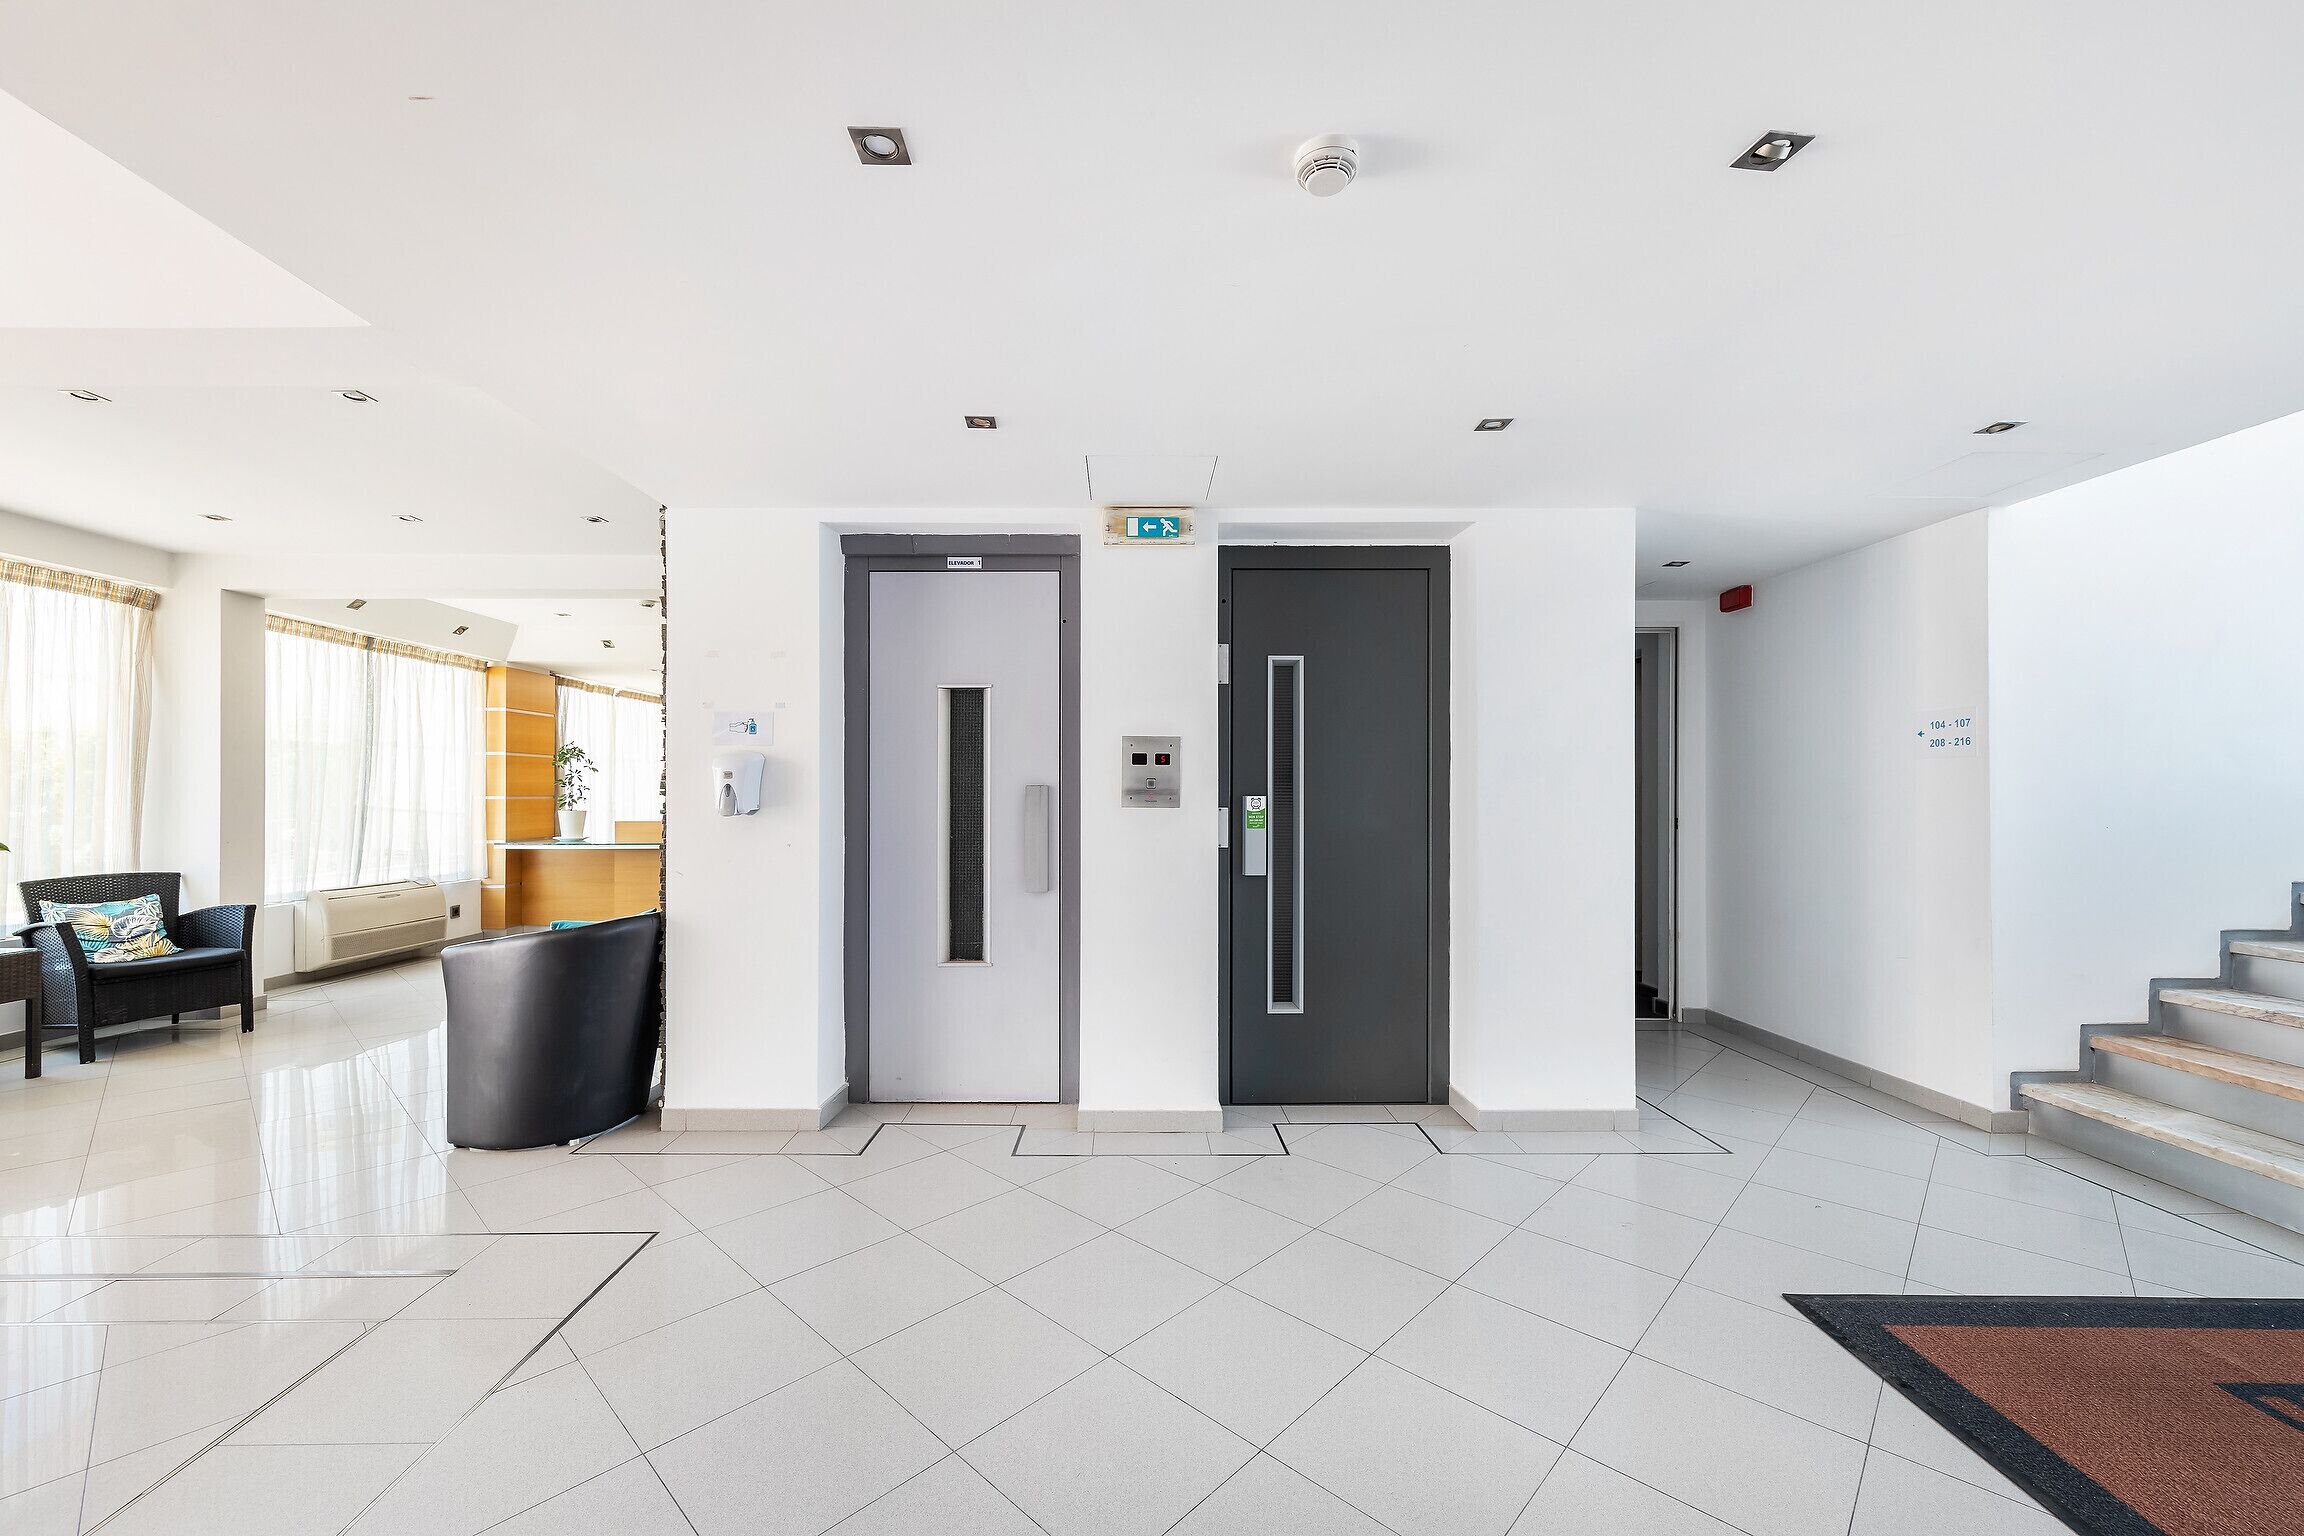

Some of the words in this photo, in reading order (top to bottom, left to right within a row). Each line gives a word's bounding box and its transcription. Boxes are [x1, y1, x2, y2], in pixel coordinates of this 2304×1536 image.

[1930, 720, 1946, 730] 104
[1954, 718, 1971, 728] 107
[1929, 738, 1946, 748] 208
[1954, 736, 1971, 746] 216
